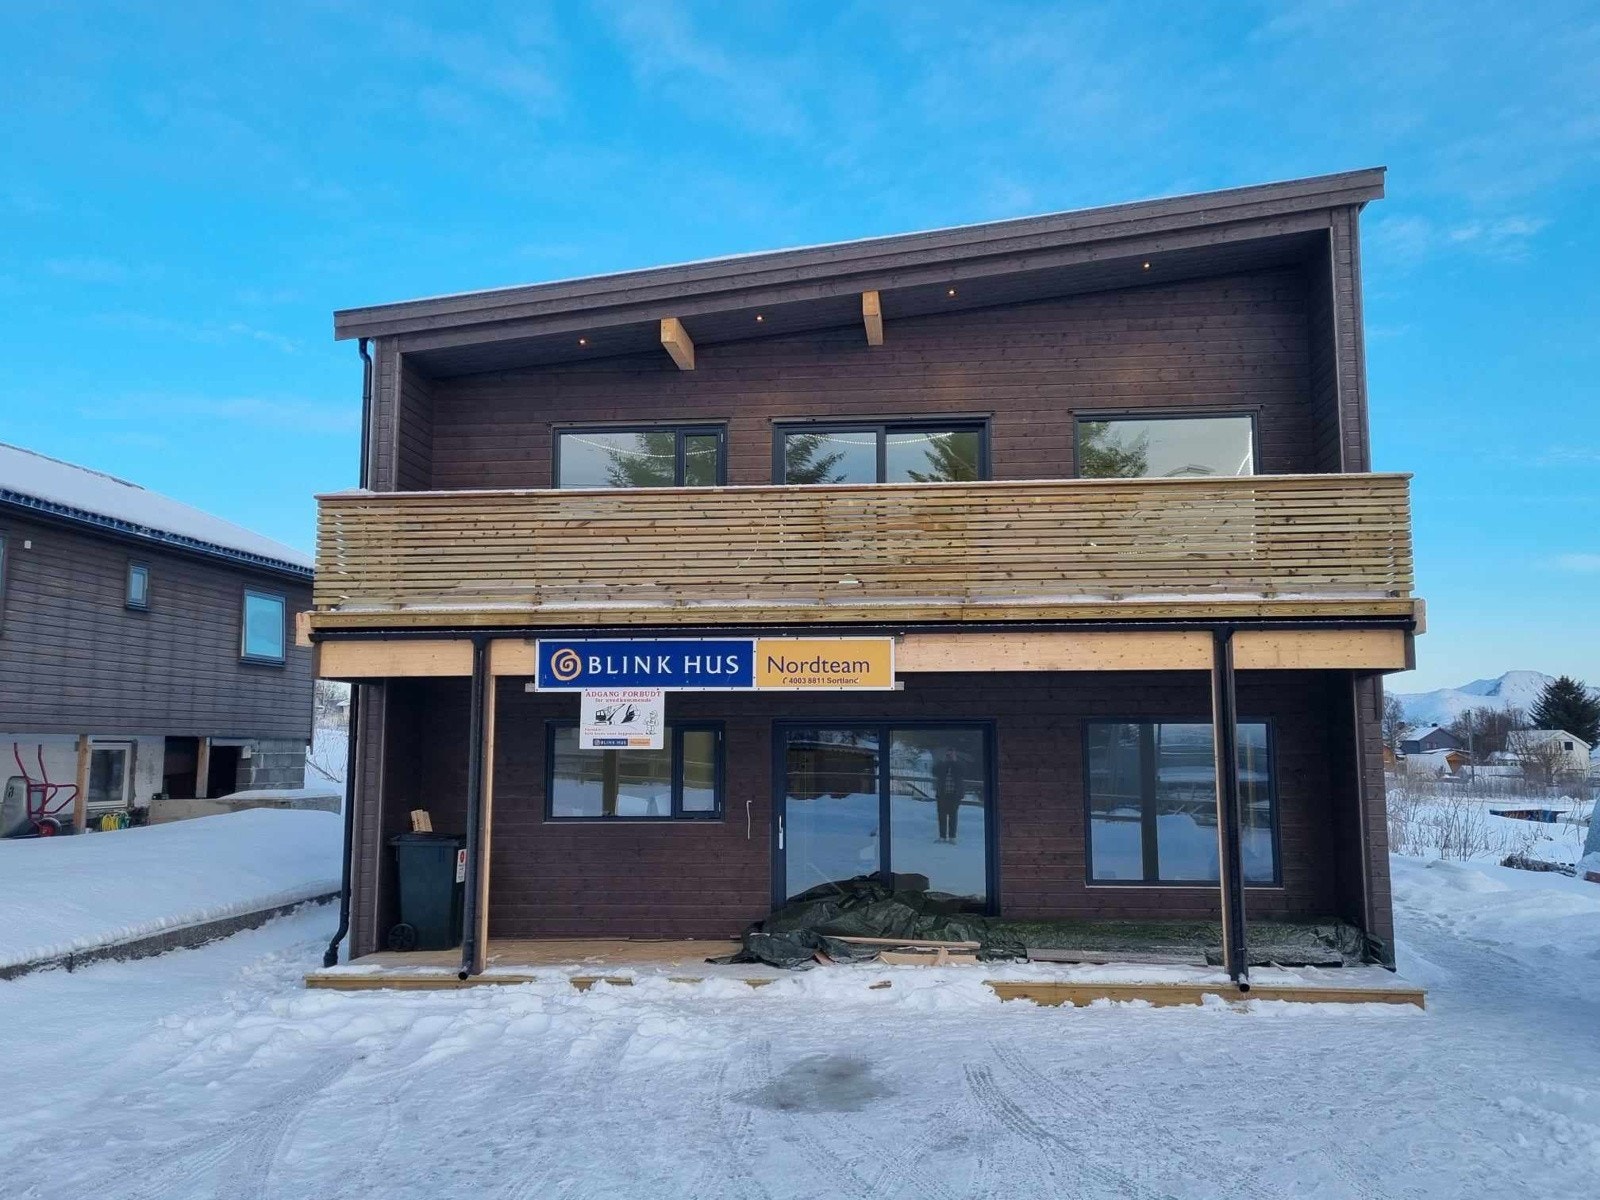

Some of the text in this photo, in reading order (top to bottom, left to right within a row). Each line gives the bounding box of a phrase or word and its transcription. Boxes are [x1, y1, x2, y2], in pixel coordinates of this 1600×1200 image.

[588, 655, 739, 674] BLINK HUS
[767, 655, 870, 674] Nordteam
[788, 677, 806, 685] 4003
[808, 677, 825, 685] 8811
